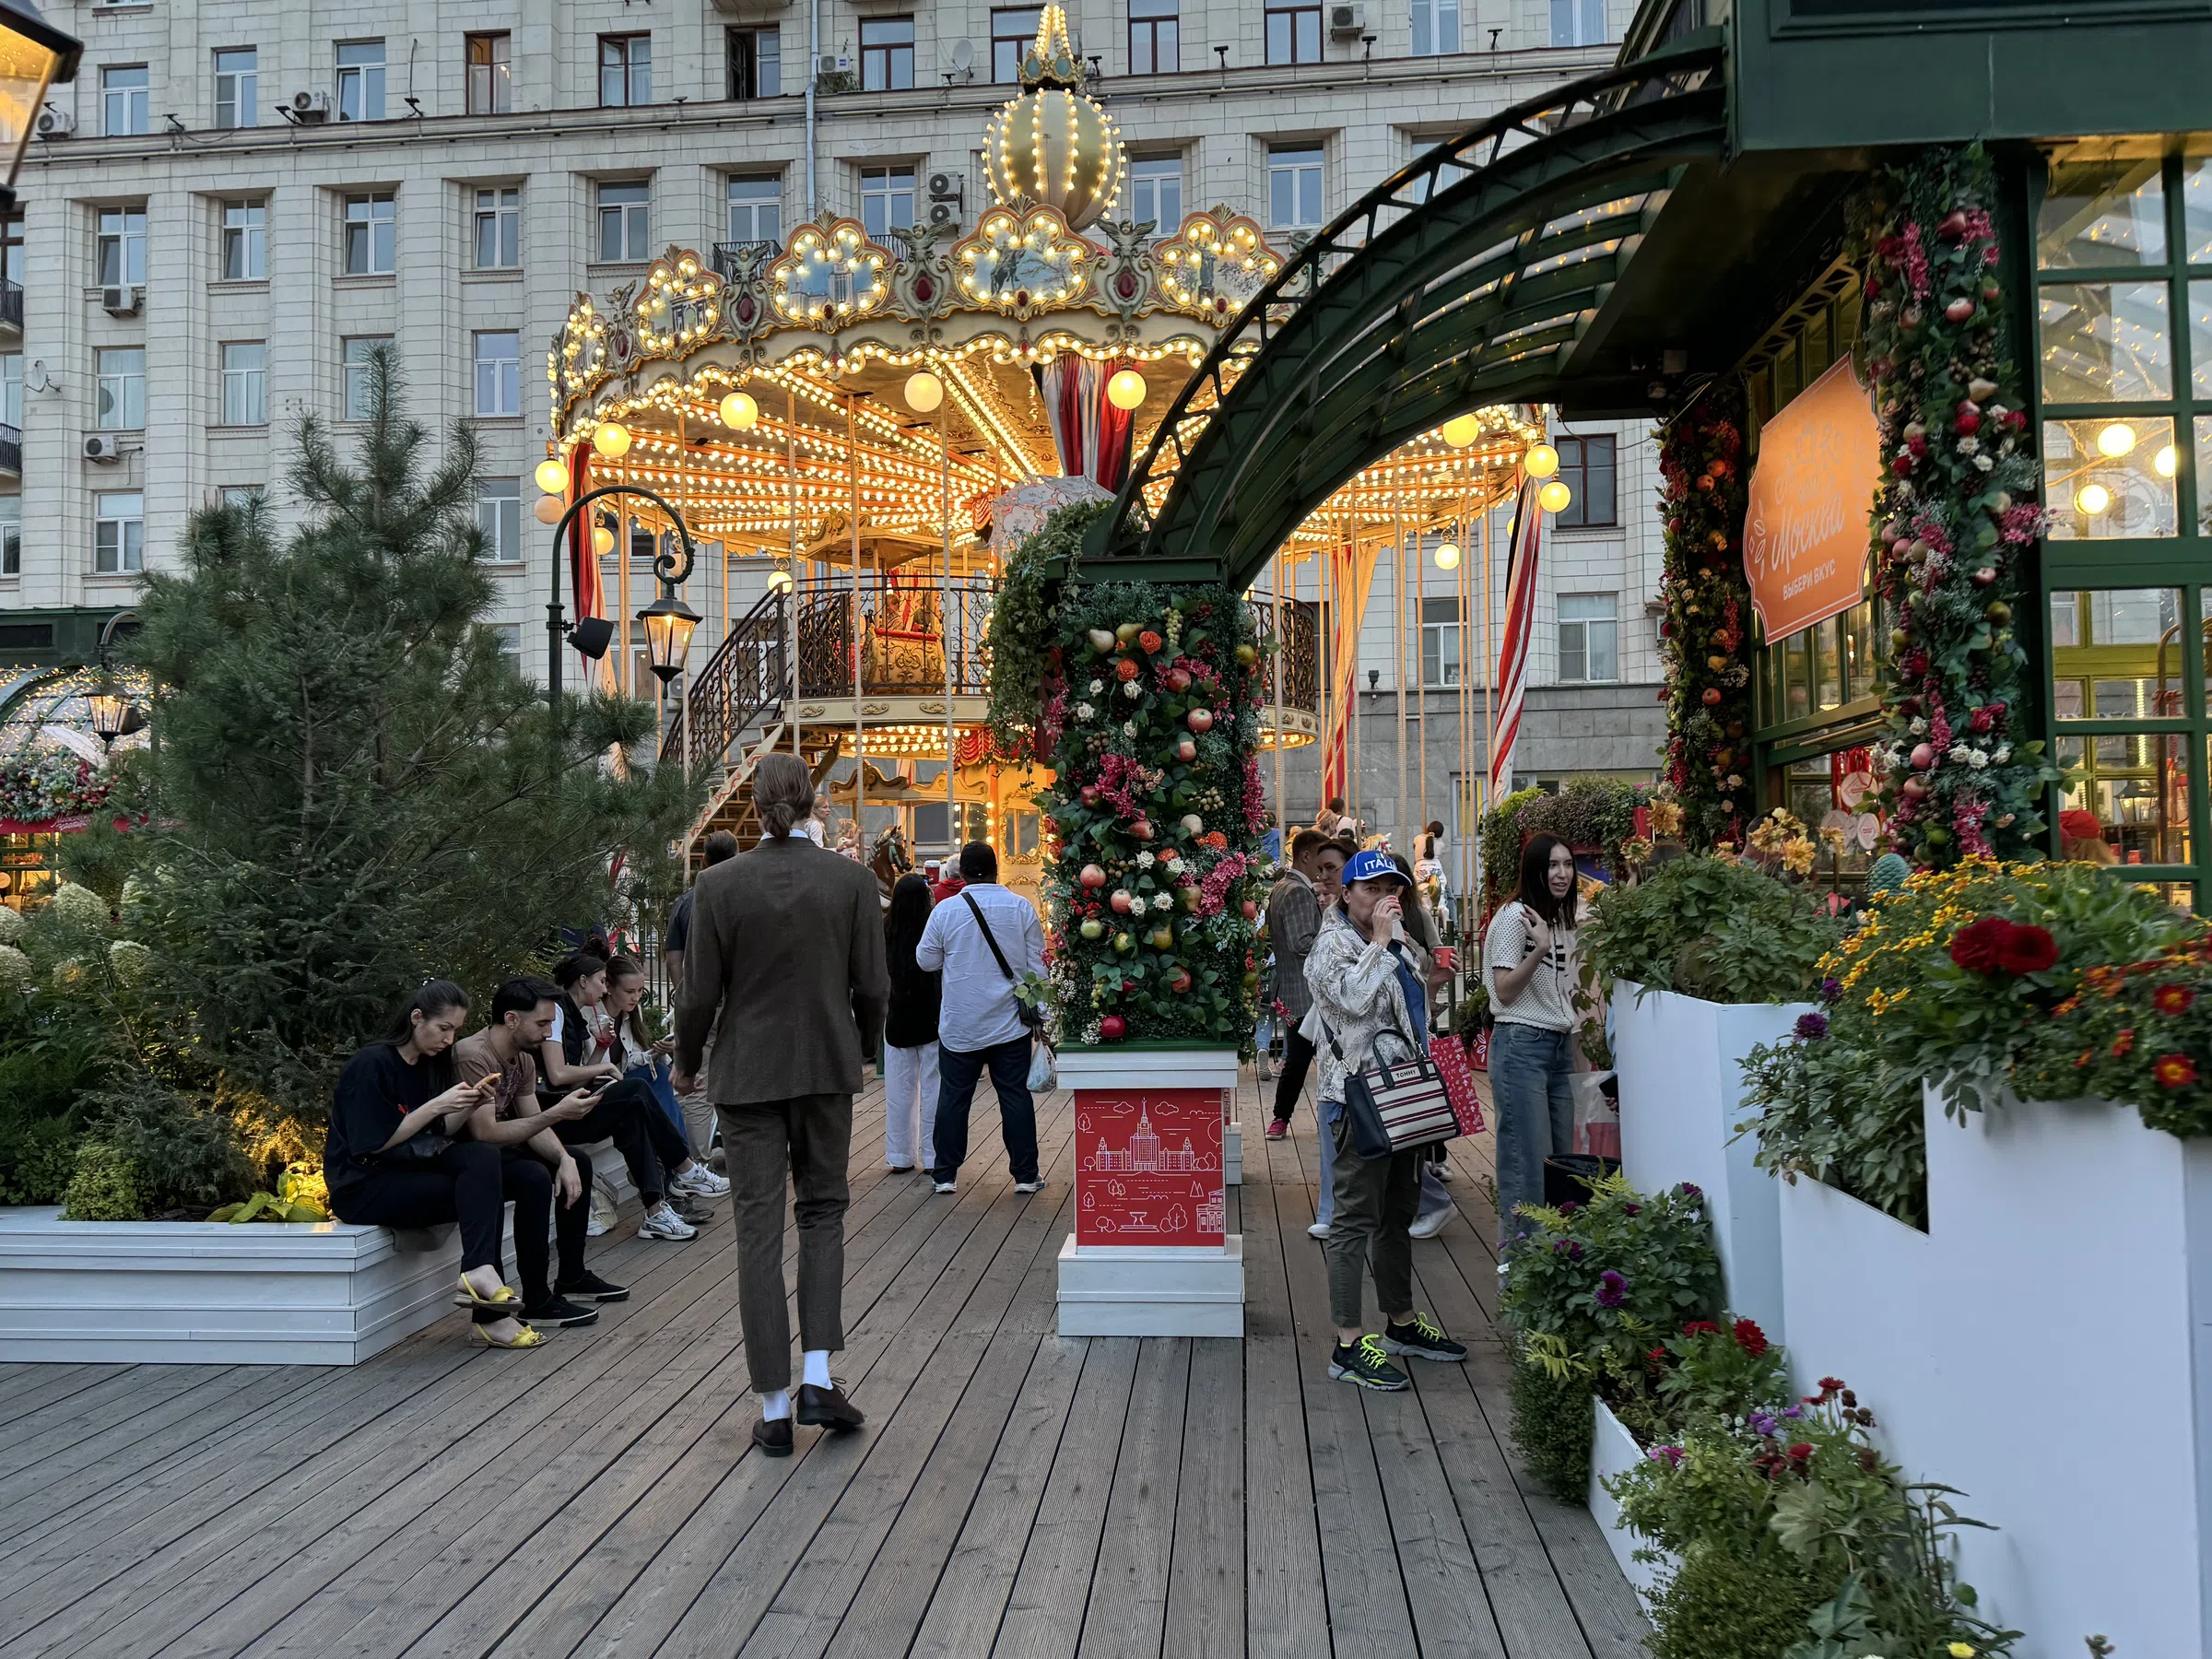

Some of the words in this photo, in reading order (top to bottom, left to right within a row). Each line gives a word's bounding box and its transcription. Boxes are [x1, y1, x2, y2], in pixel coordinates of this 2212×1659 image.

[1771, 476, 1845, 574] Москва
[1783, 571, 1813, 601] ВЫБЕРИ
[1814, 559, 1836, 585] ВКУС
[1395, 1069, 1416, 1078] TOMMY
